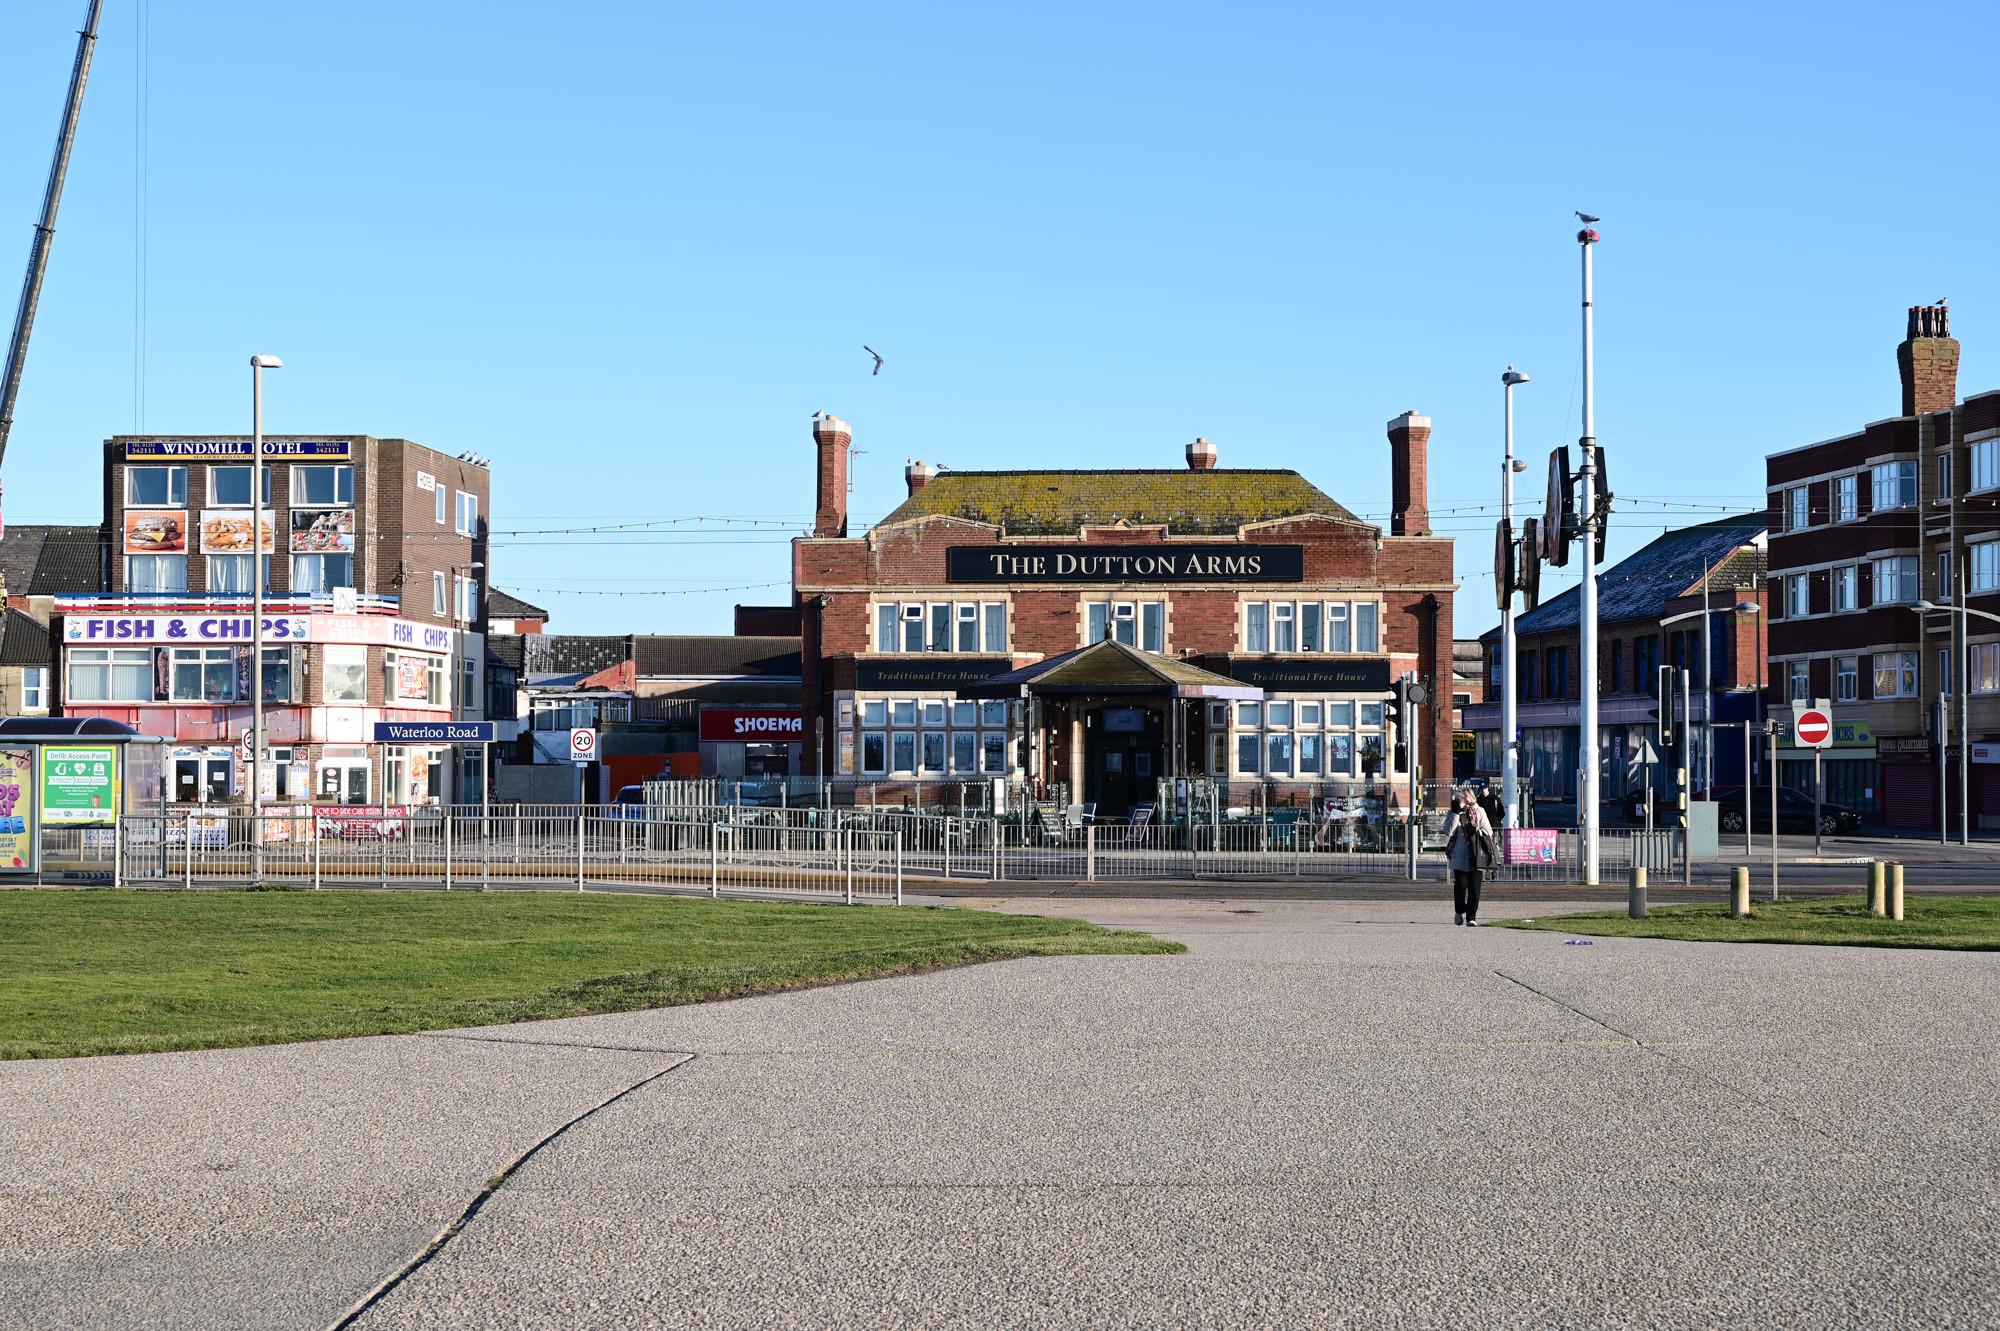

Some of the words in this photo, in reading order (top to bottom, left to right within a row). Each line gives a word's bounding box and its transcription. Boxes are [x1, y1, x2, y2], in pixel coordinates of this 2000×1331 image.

[162, 443, 245, 454] WINDMILL
[990, 553, 1046, 575] THE
[1055, 553, 1177, 576] DUTTON
[1184, 553, 1262, 575] ARMS
[87, 618, 154, 640] FISH
[165, 618, 188, 638] &
[198, 618, 290, 639] CHIPS
[328, 619, 357, 628] FISH
[362, 620, 371, 628] &
[329, 628, 369, 638] CHIPS
[394, 623, 412, 643] FISH
[424, 628, 448, 649] CHIPS
[878, 672, 935, 680] Traditional
[937, 672, 958, 680] Free
[959, 672, 990, 680] House
[1252, 672, 1310, 681] Traditional
[1313, 672, 1334, 681] Free
[1336, 672, 1367, 681] House
[734, 717, 802, 733] SHOEMA
[388, 726, 444, 738] Waterloo
[447, 726, 479, 738] Road
[576, 736, 591, 745] 20
